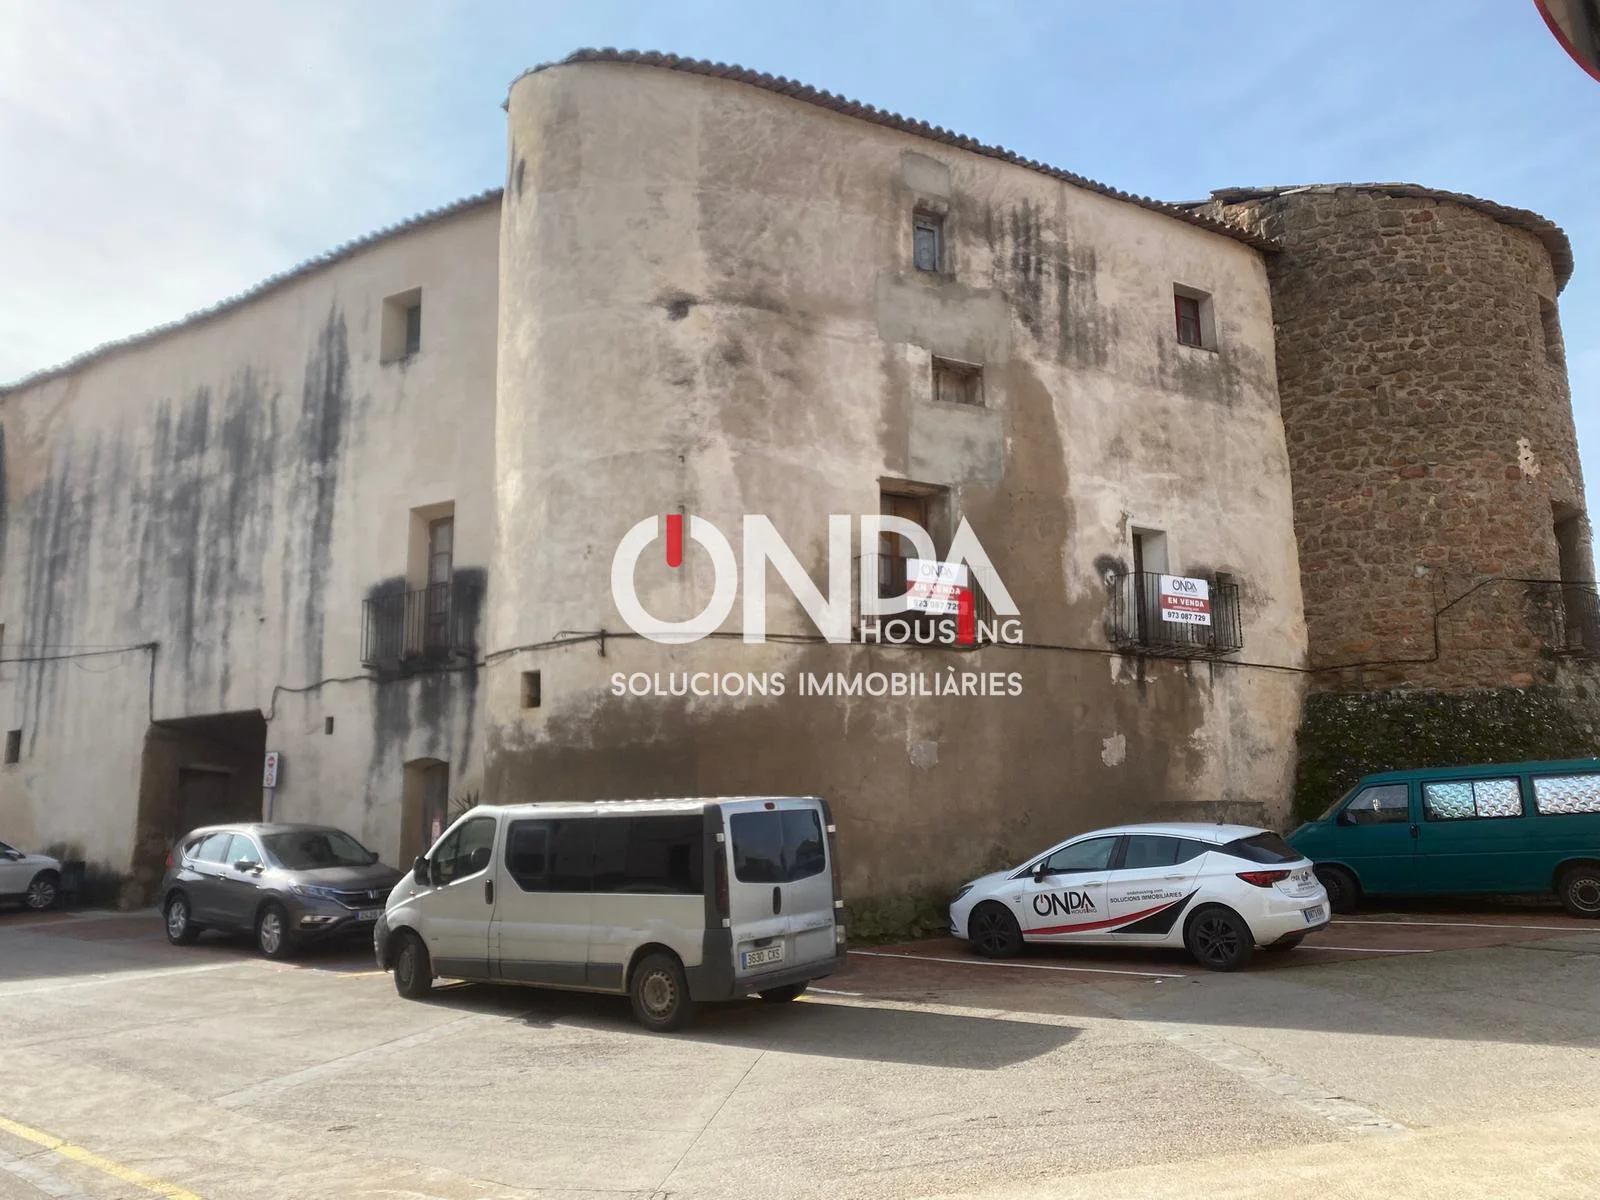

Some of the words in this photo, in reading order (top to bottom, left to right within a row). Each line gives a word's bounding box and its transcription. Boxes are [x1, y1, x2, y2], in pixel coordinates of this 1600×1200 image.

[1172, 579, 1198, 592] ONDA
[1180, 599, 1204, 608] VENDA
[1033, 891, 1095, 917] ONDA
[1110, 895, 1141, 904] SOLUCIONS
